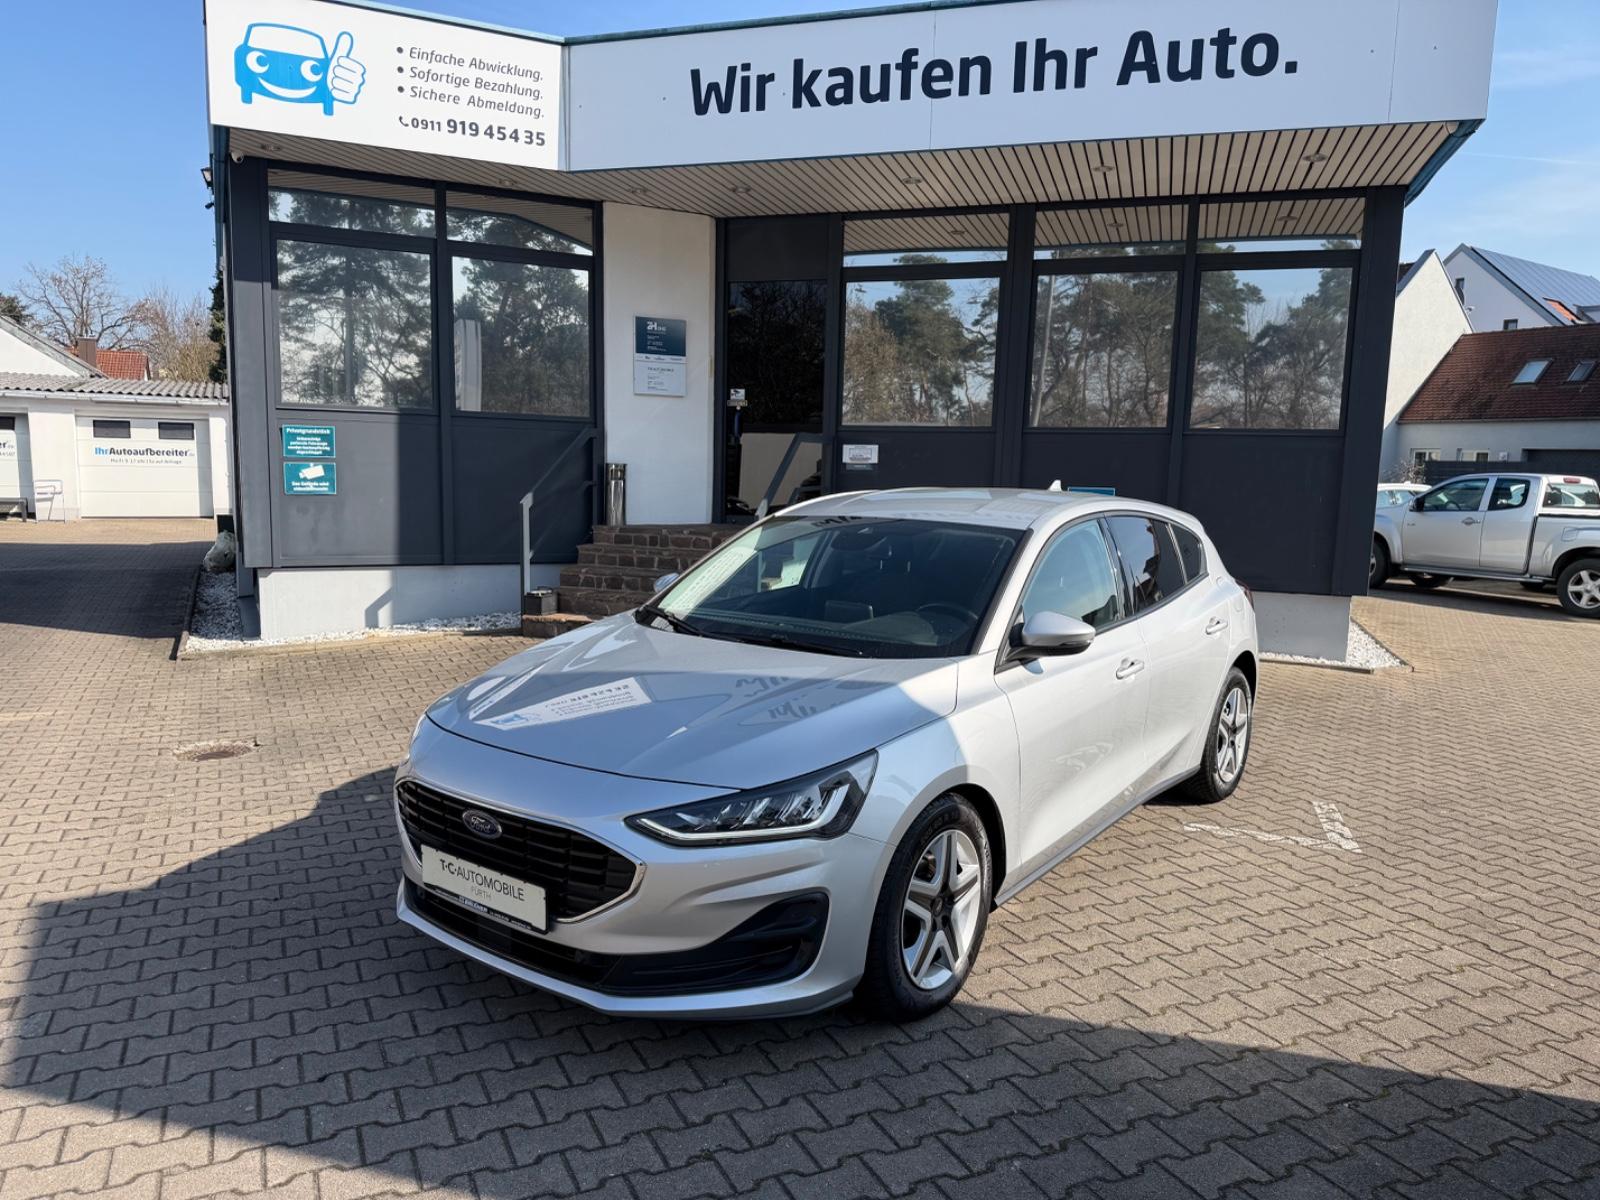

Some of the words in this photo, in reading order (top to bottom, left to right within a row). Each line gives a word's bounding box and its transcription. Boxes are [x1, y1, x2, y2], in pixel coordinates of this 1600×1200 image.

[409, 46, 465, 67] Einfache
[468, 57, 544, 82] Abwicklung.
[689, 62, 776, 117] Wir
[791, 48, 992, 109] kaufen
[1012, 38, 1099, 93] Ihr
[1116, 27, 1299, 86] Auto.
[409, 66, 470, 88] Sofortige
[474, 76, 544, 101] Bezahlung.
[409, 86, 461, 105] Sichere
[466, 94, 545, 119] Abmeldung.
[410, 117, 442, 133] 0911
[446, 118, 480, 137] 919
[471, 815, 491, 834] Ford
